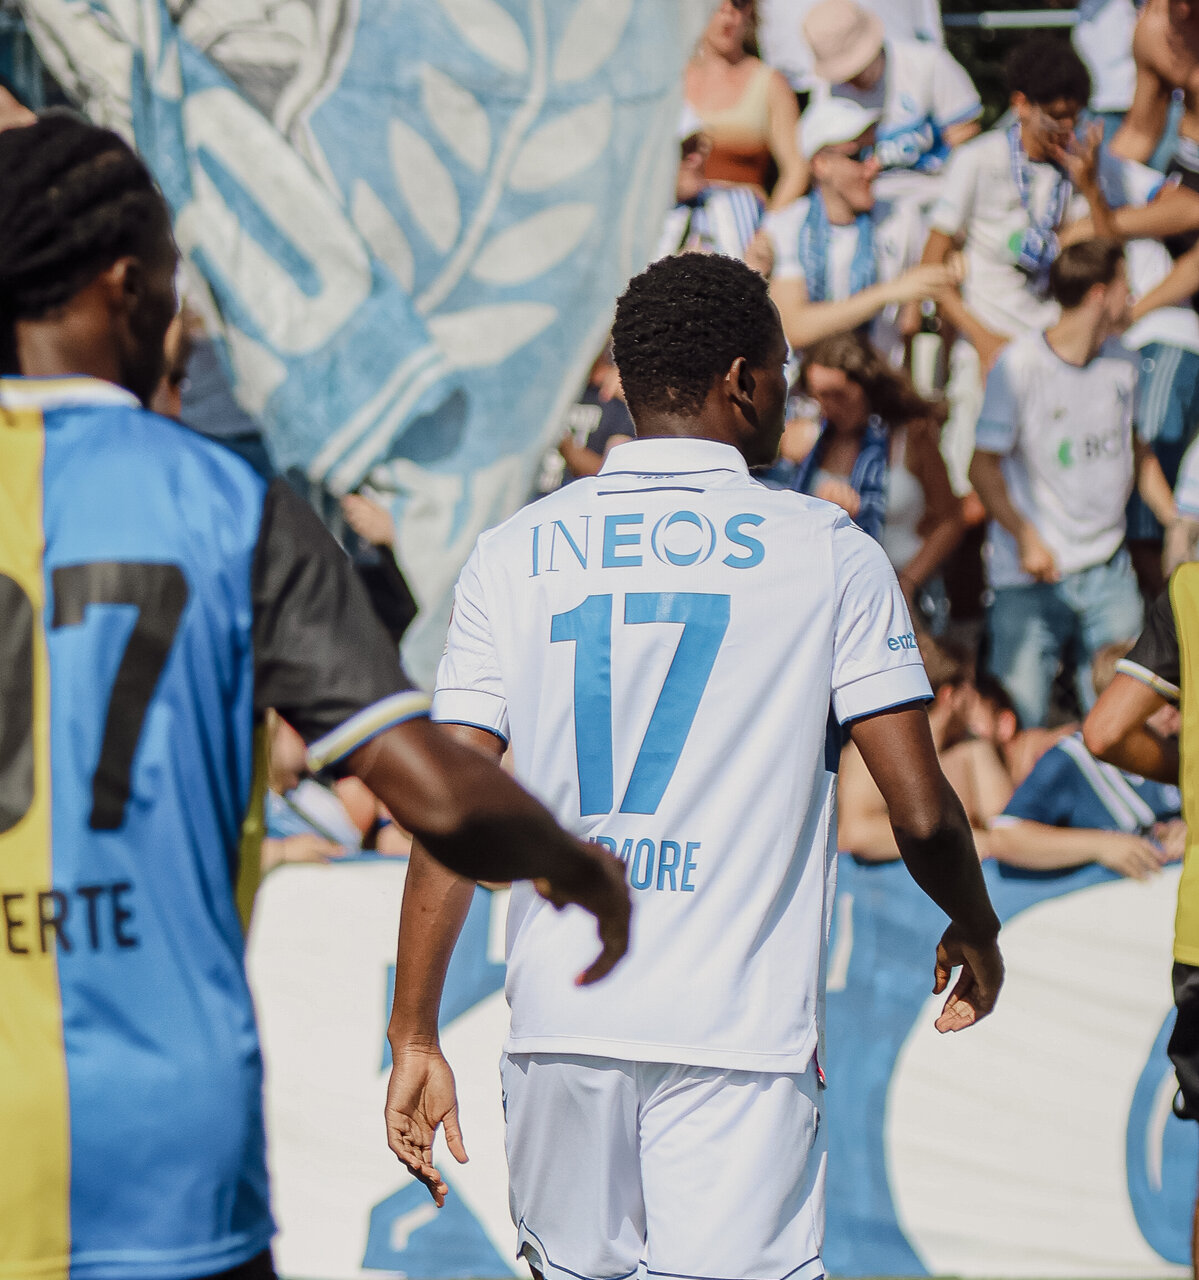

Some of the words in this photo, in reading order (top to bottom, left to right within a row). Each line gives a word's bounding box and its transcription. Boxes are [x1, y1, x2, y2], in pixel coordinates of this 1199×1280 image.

[528, 509, 767, 578] INEOS
[886, 631, 918, 652] enz
[549, 591, 731, 818] 17
